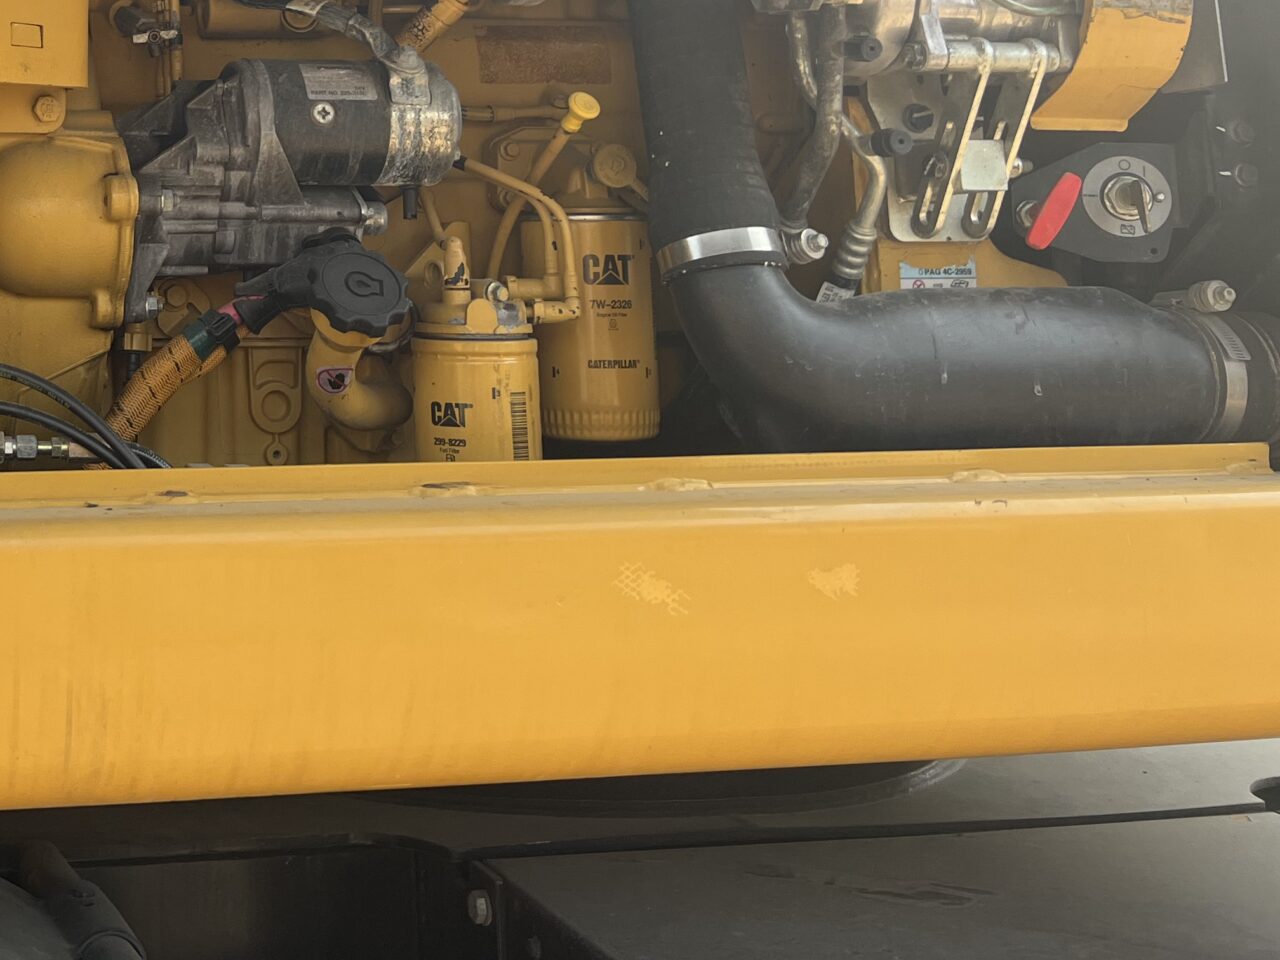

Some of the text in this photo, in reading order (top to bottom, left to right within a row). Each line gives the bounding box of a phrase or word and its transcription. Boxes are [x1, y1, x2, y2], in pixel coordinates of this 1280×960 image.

[582, 254, 630, 286] CAT
[590, 300, 632, 309] 7W-2326
[587, 360, 638, 369] CATERPILLAR
[431, 401, 468, 428] CAT
